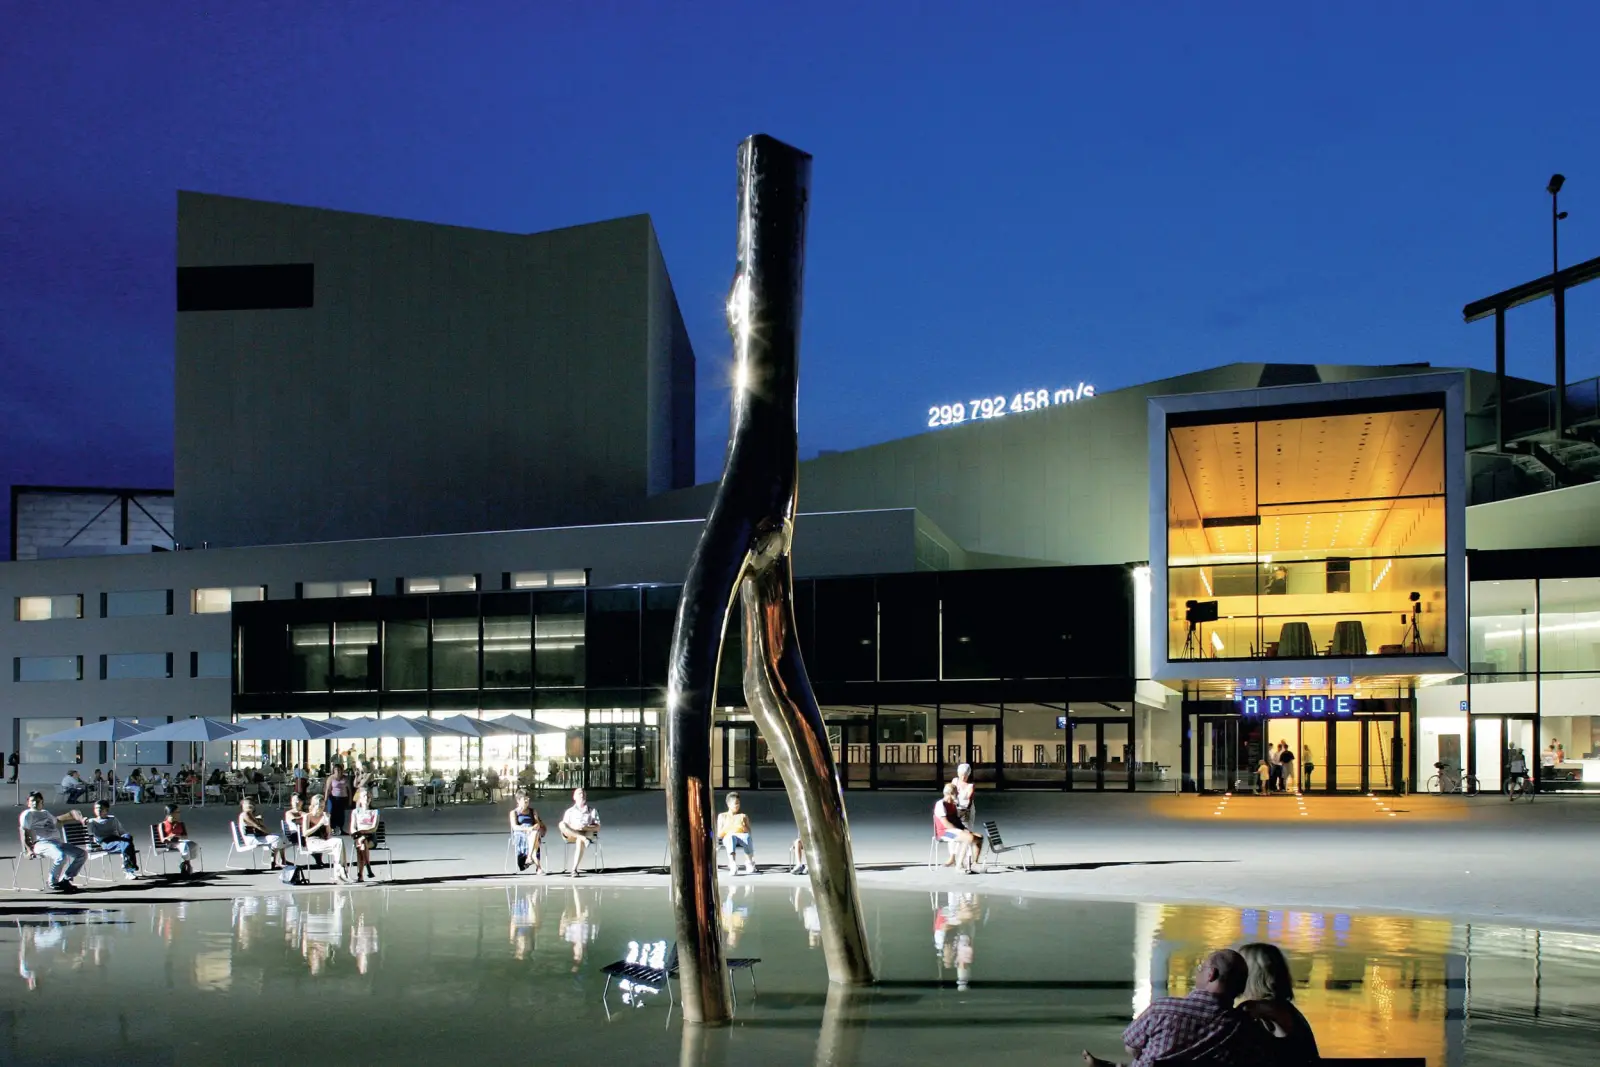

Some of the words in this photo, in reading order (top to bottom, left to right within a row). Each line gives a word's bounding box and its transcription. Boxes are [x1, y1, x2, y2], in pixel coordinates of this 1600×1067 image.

[928, 403, 965, 427] 299
[969, 396, 1006, 420] 792
[1010, 389, 1049, 413] 458
[1054, 382, 1096, 404] m/s
[1245, 698, 1258, 714] A
[1270, 697, 1282, 713] B
[1291, 697, 1303, 713] C
[1312, 697, 1324, 713] D
[1337, 696, 1350, 712] E
